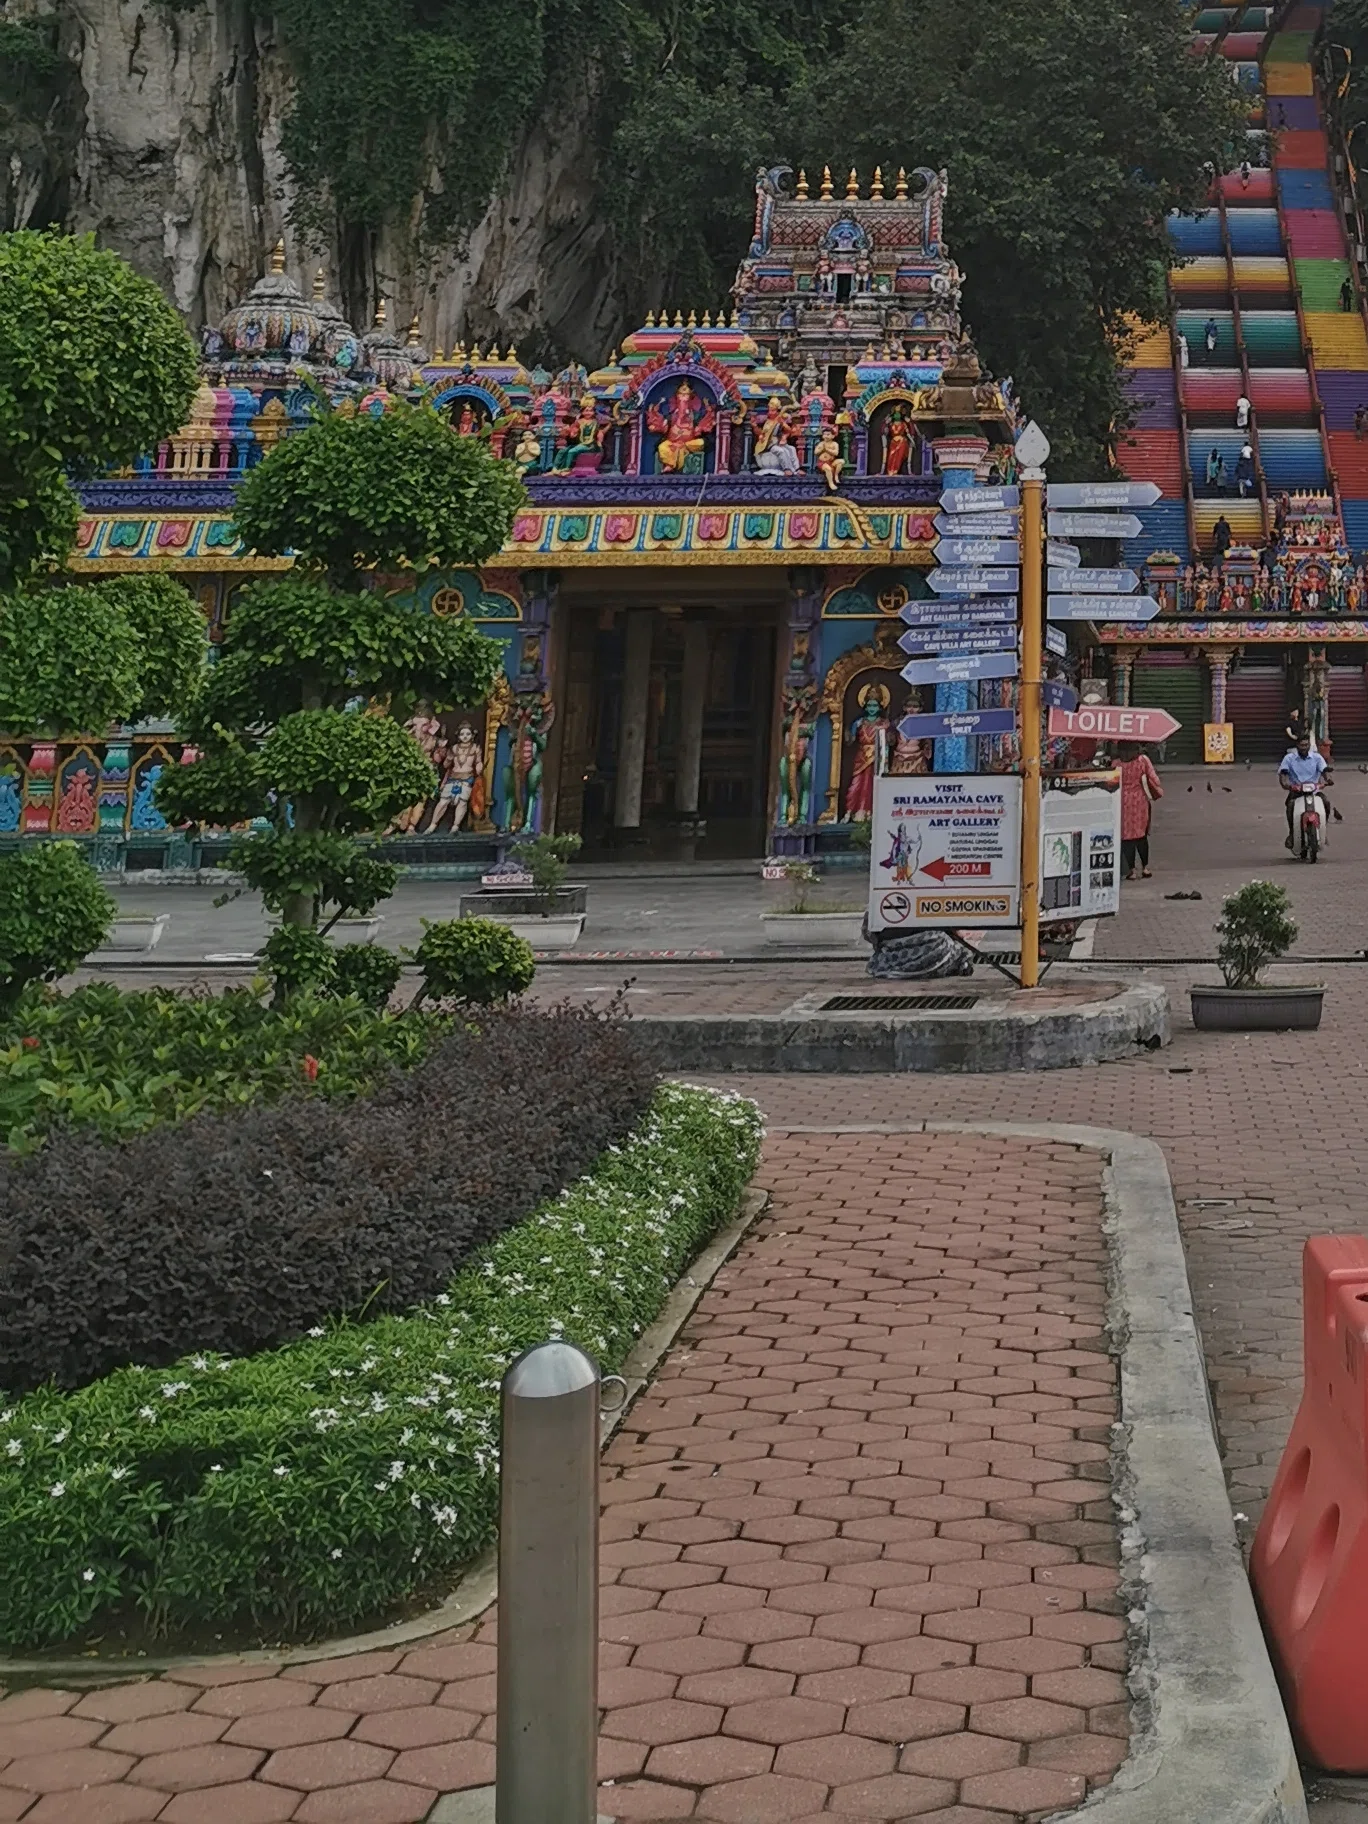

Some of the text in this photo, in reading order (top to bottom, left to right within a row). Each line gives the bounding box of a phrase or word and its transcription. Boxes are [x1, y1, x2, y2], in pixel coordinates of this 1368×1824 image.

[920, 615, 933, 623] ART
[933, 614, 961, 622] GALLERY
[924, 643, 941, 651] CAVE
[941, 642, 959, 650] VILLA
[972, 639, 1001, 648] GALLERY
[1064, 710, 1150, 734] TOILET
[935, 784, 964, 793] VISIT
[893, 795, 1004, 805] SRI RAMAYANA CAVE
[928, 818, 1000, 828] ART GALLERY
[949, 863, 982, 874] 200 M
[921, 899, 1007, 913] NO SMOKING
